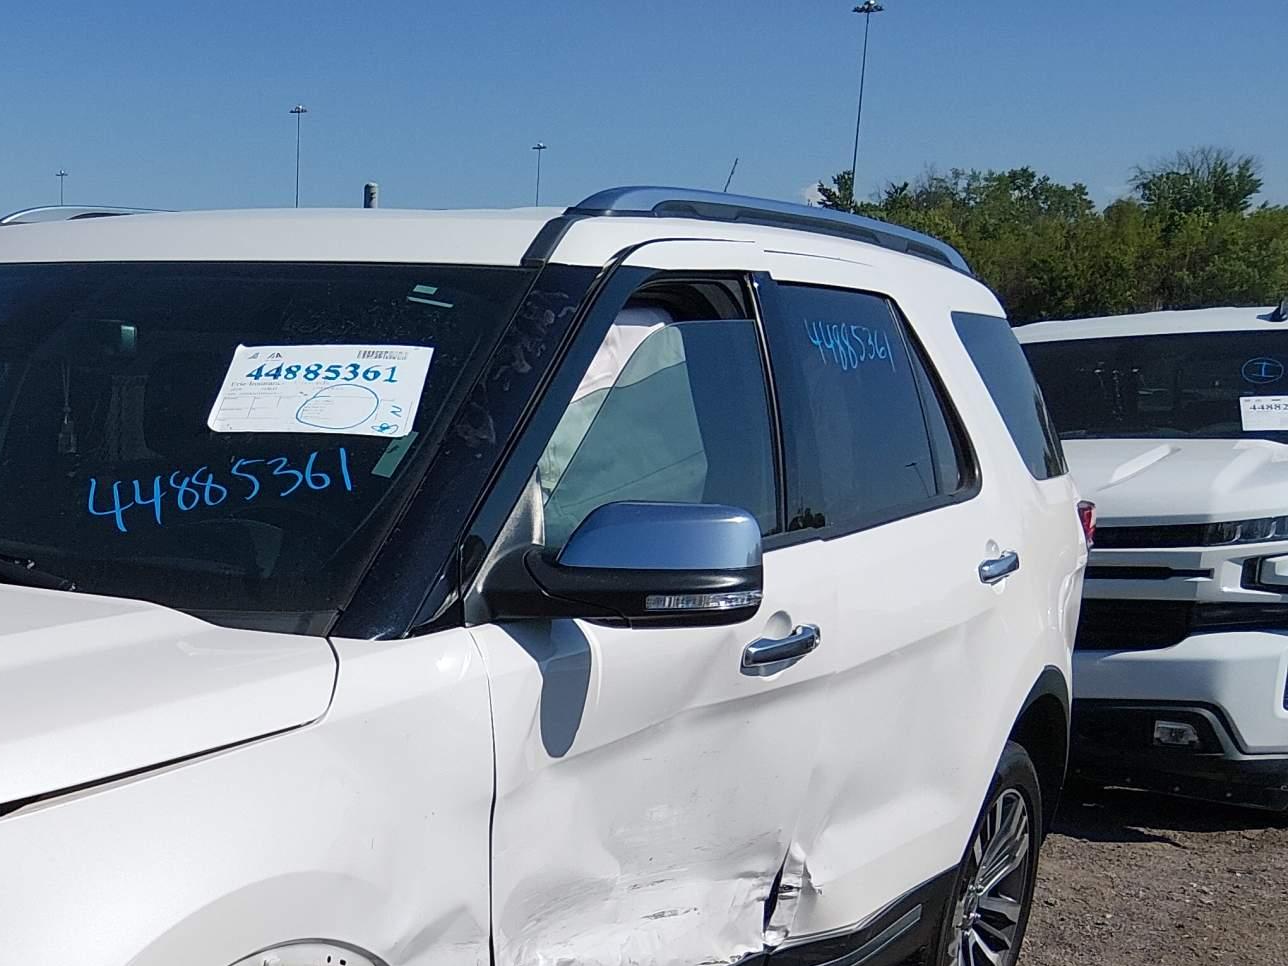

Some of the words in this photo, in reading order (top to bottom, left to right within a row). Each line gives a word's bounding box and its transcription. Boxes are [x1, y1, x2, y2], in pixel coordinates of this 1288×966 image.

[245, 361, 398, 384] 44885361
[803, 318, 896, 373] 44885361
[88, 447, 352, 532] 44885361
